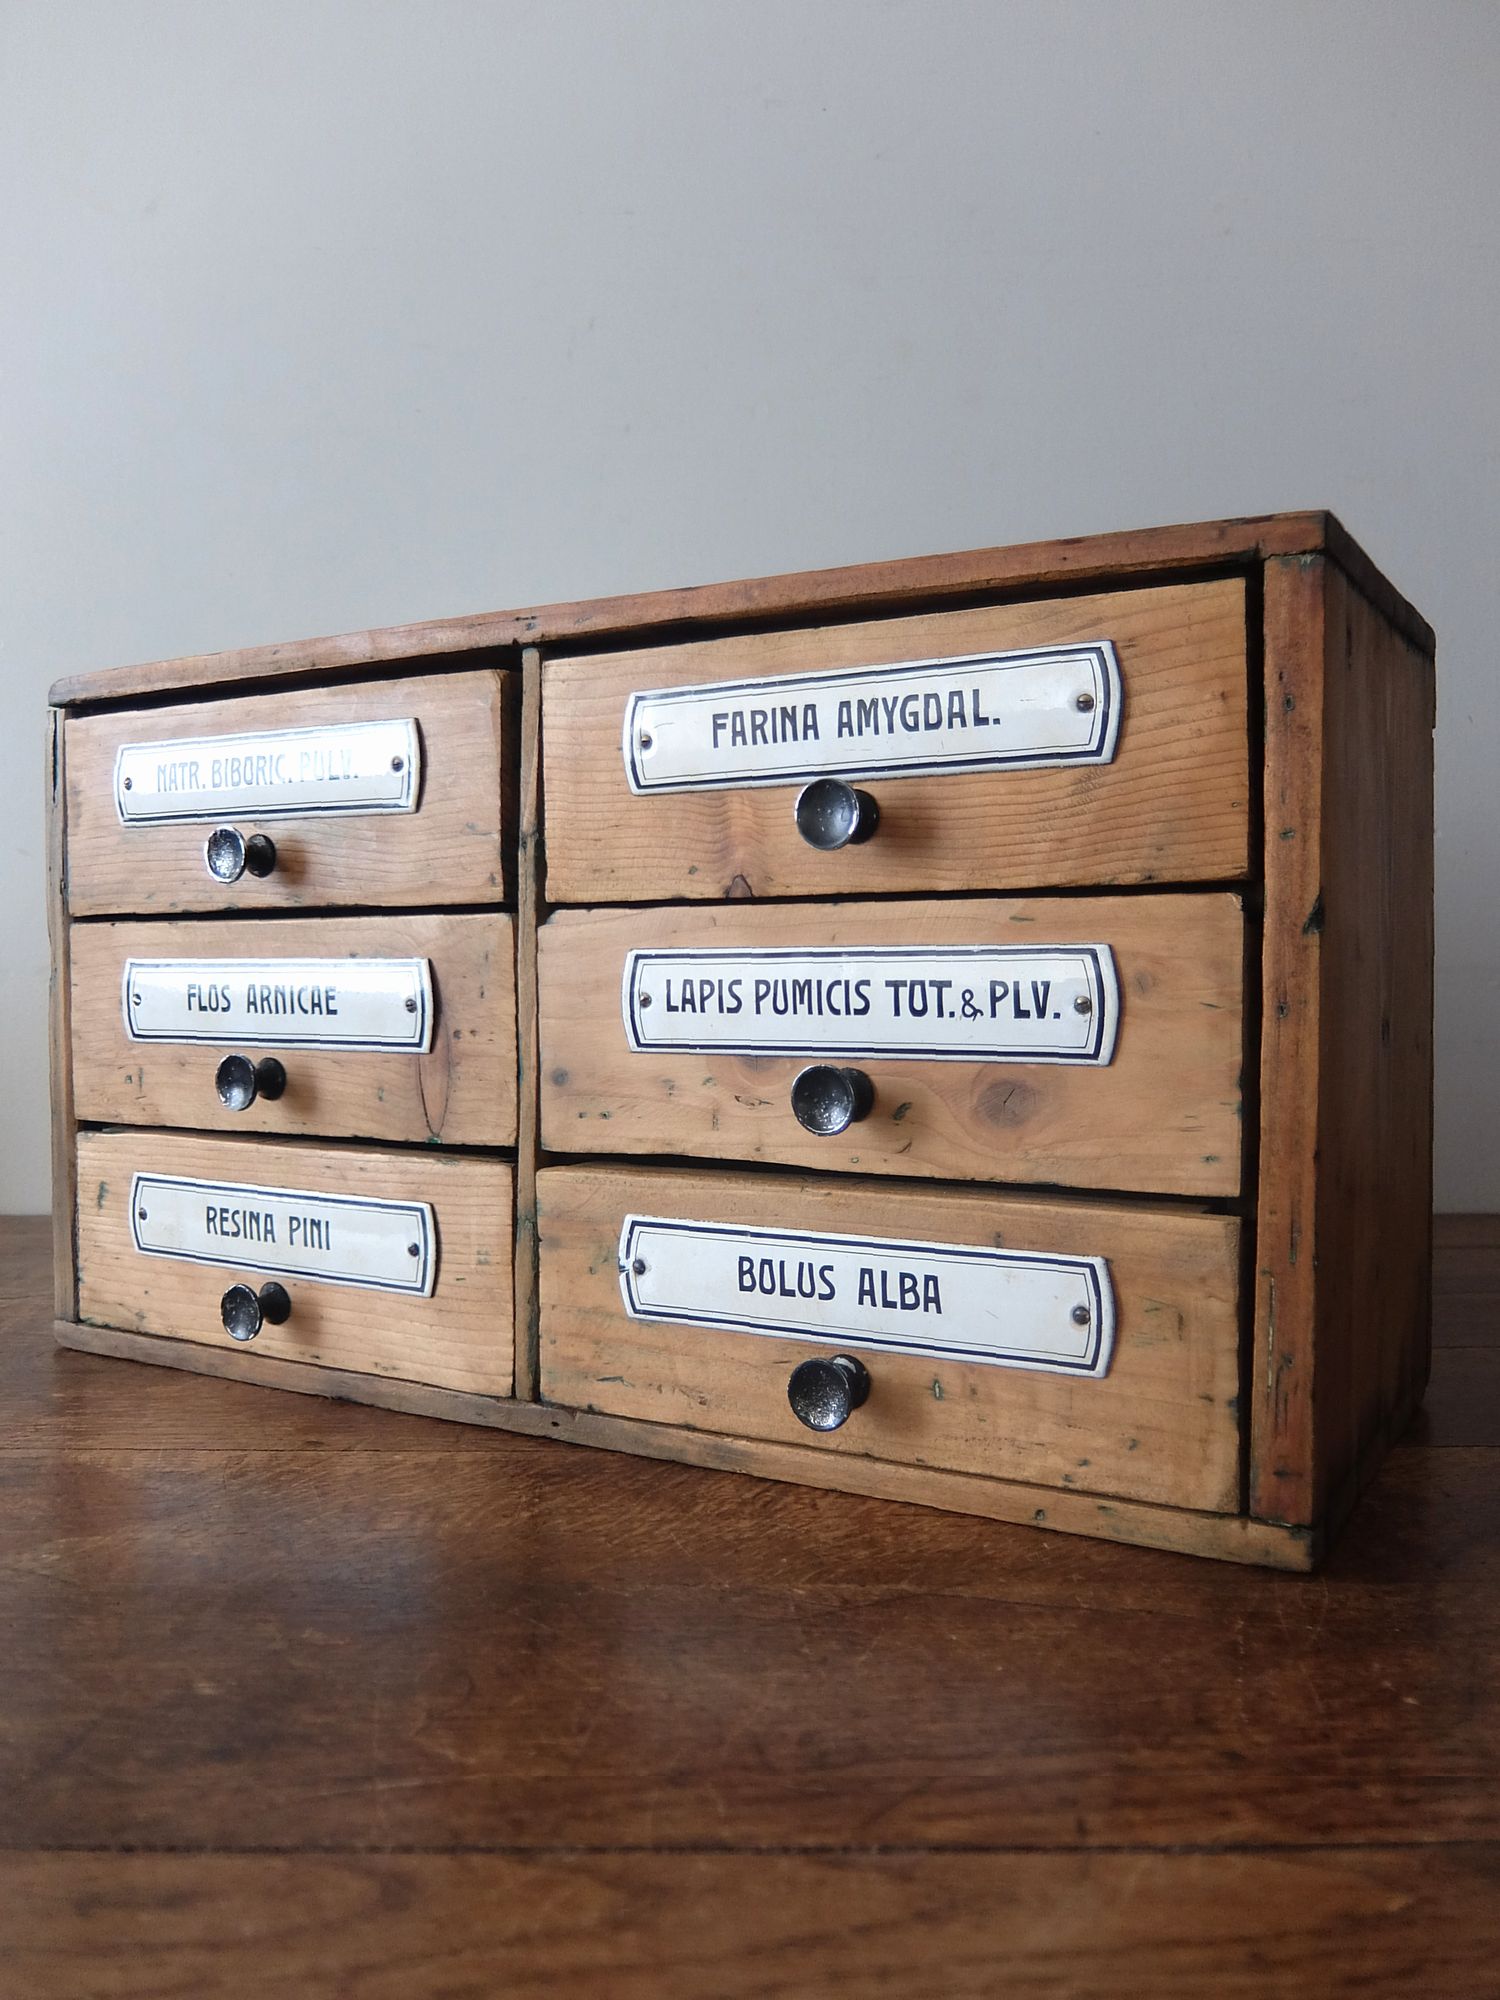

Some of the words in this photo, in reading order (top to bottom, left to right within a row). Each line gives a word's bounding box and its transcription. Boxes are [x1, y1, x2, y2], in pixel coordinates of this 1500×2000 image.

[711, 704, 821, 749] FARINA
[837, 688, 1001, 738] AMYGDAL.
[157, 763, 206, 792] NATR.
[211, 754, 293, 787] BIBORIC.
[187, 983, 231, 1013] FLOS
[246, 984, 338, 1015] ARNICAE
[664, 978, 743, 1014] LAPIS
[753, 978, 872, 1016] PUMICIS
[988, 979, 1062, 1020] PLV.
[206, 1205, 276, 1244] RESINA
[288, 1215, 331, 1251] PINI
[737, 1255, 836, 1300] BOLUS
[857, 1267, 943, 1315] ALBA
